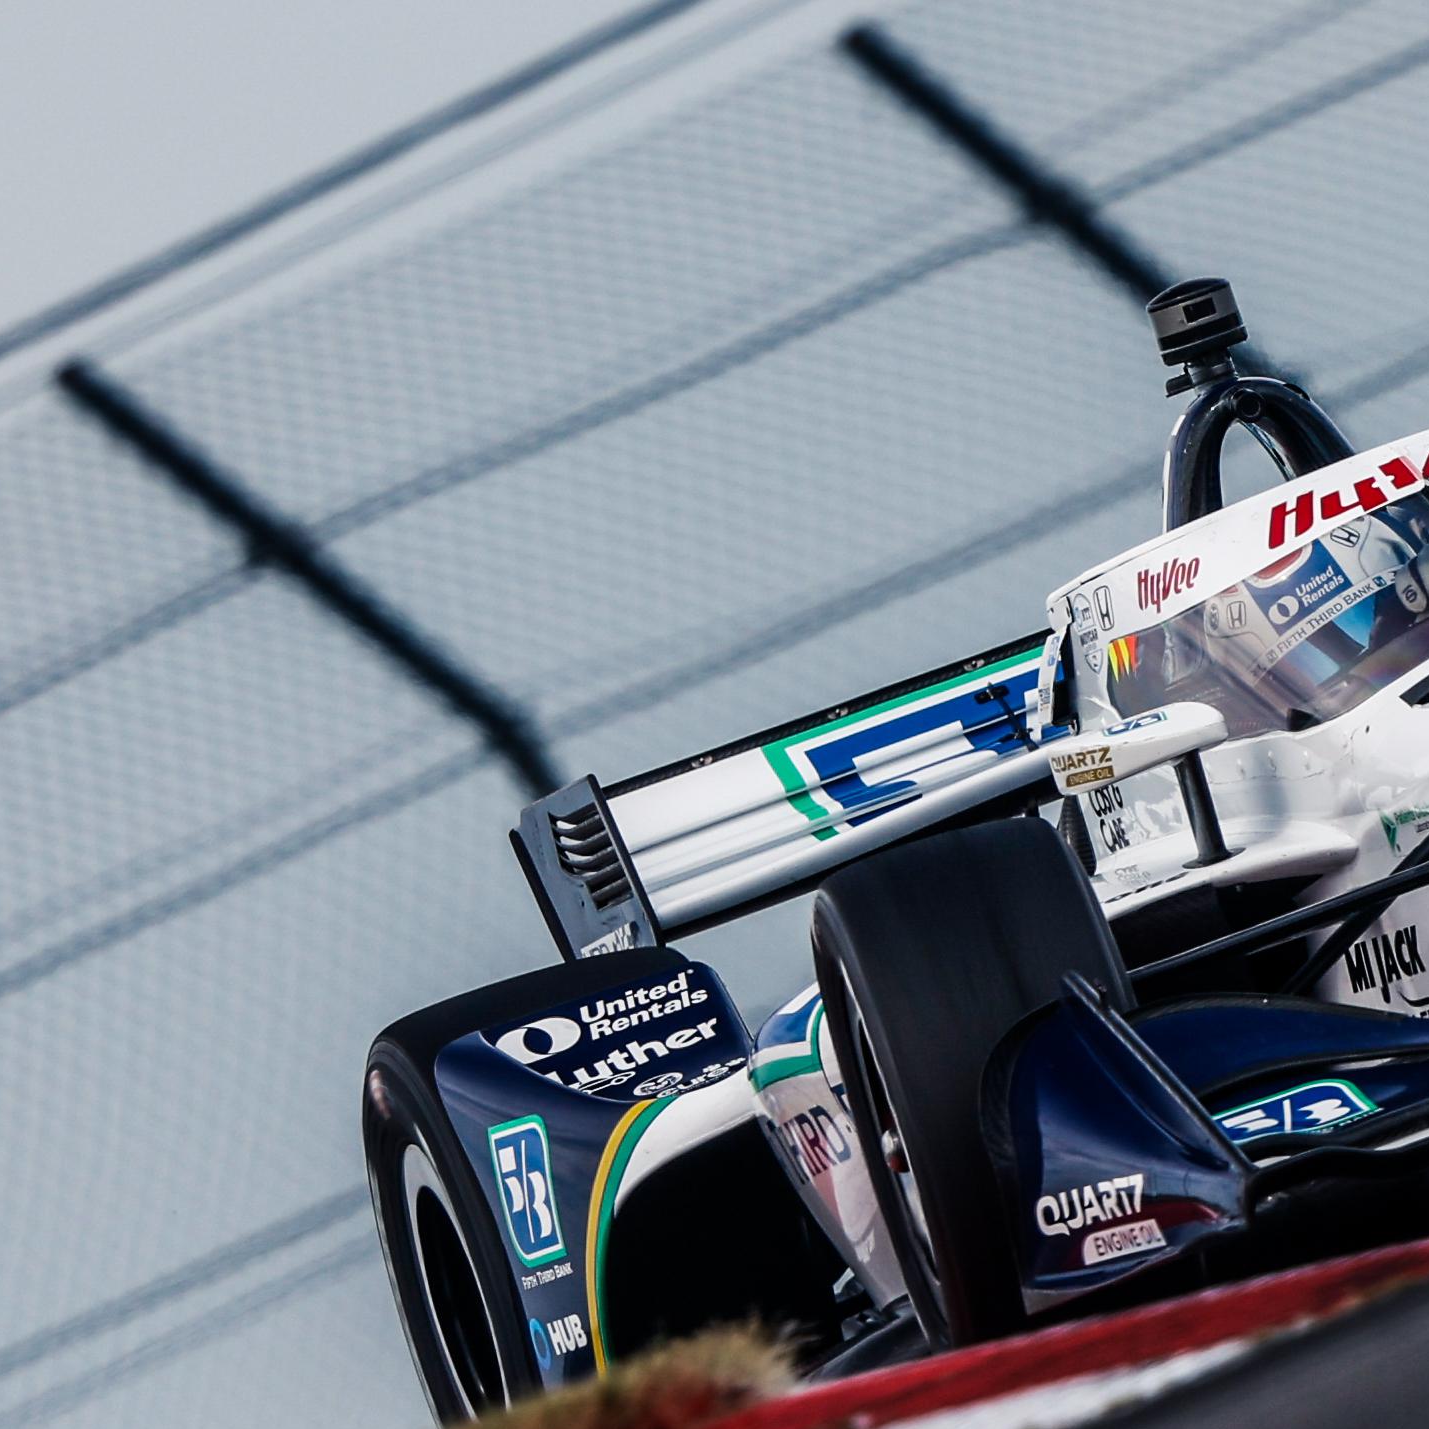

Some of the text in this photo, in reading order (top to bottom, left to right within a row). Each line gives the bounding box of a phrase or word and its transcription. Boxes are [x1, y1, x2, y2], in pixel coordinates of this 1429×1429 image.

[1137, 557, 1200, 614] HyVee
[1295, 565, 1335, 597] United
[1302, 574, 1345, 608] Rentals
[1277, 583, 1375, 653] FIFTH THIRD BANK
[1051, 746, 1112, 773] QUARTZ
[1345, 925, 1426, 1004] MI JACK
[580, 972, 688, 1024] United
[589, 988, 709, 1040] Rentals
[1093, 1222, 1163, 1257] ENGINE OIL
[547, 1314, 588, 1355] HUB
